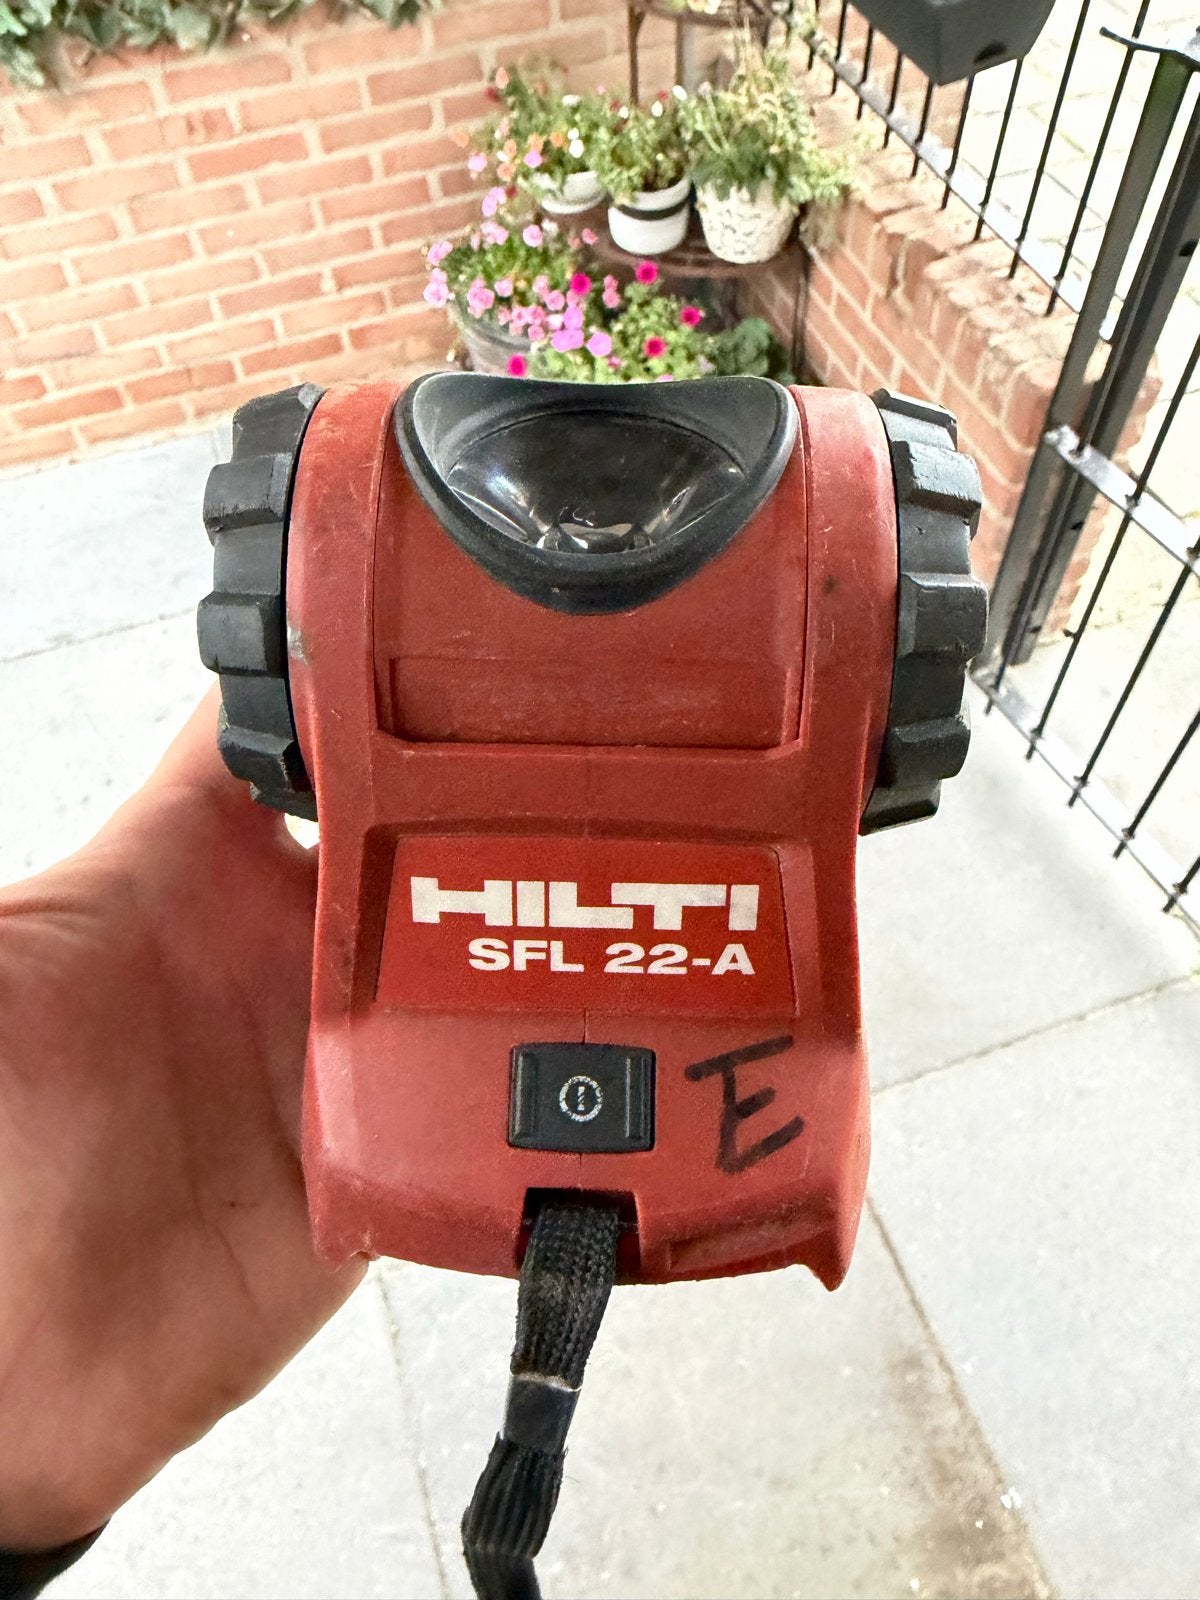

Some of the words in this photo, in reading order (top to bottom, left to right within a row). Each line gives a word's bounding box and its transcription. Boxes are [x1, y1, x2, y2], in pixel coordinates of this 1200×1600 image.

[410, 876, 760, 931] HILTI
[468, 937, 584, 973] SFL
[603, 941, 756, 976] 22-A
[684, 1035, 806, 1175] E
